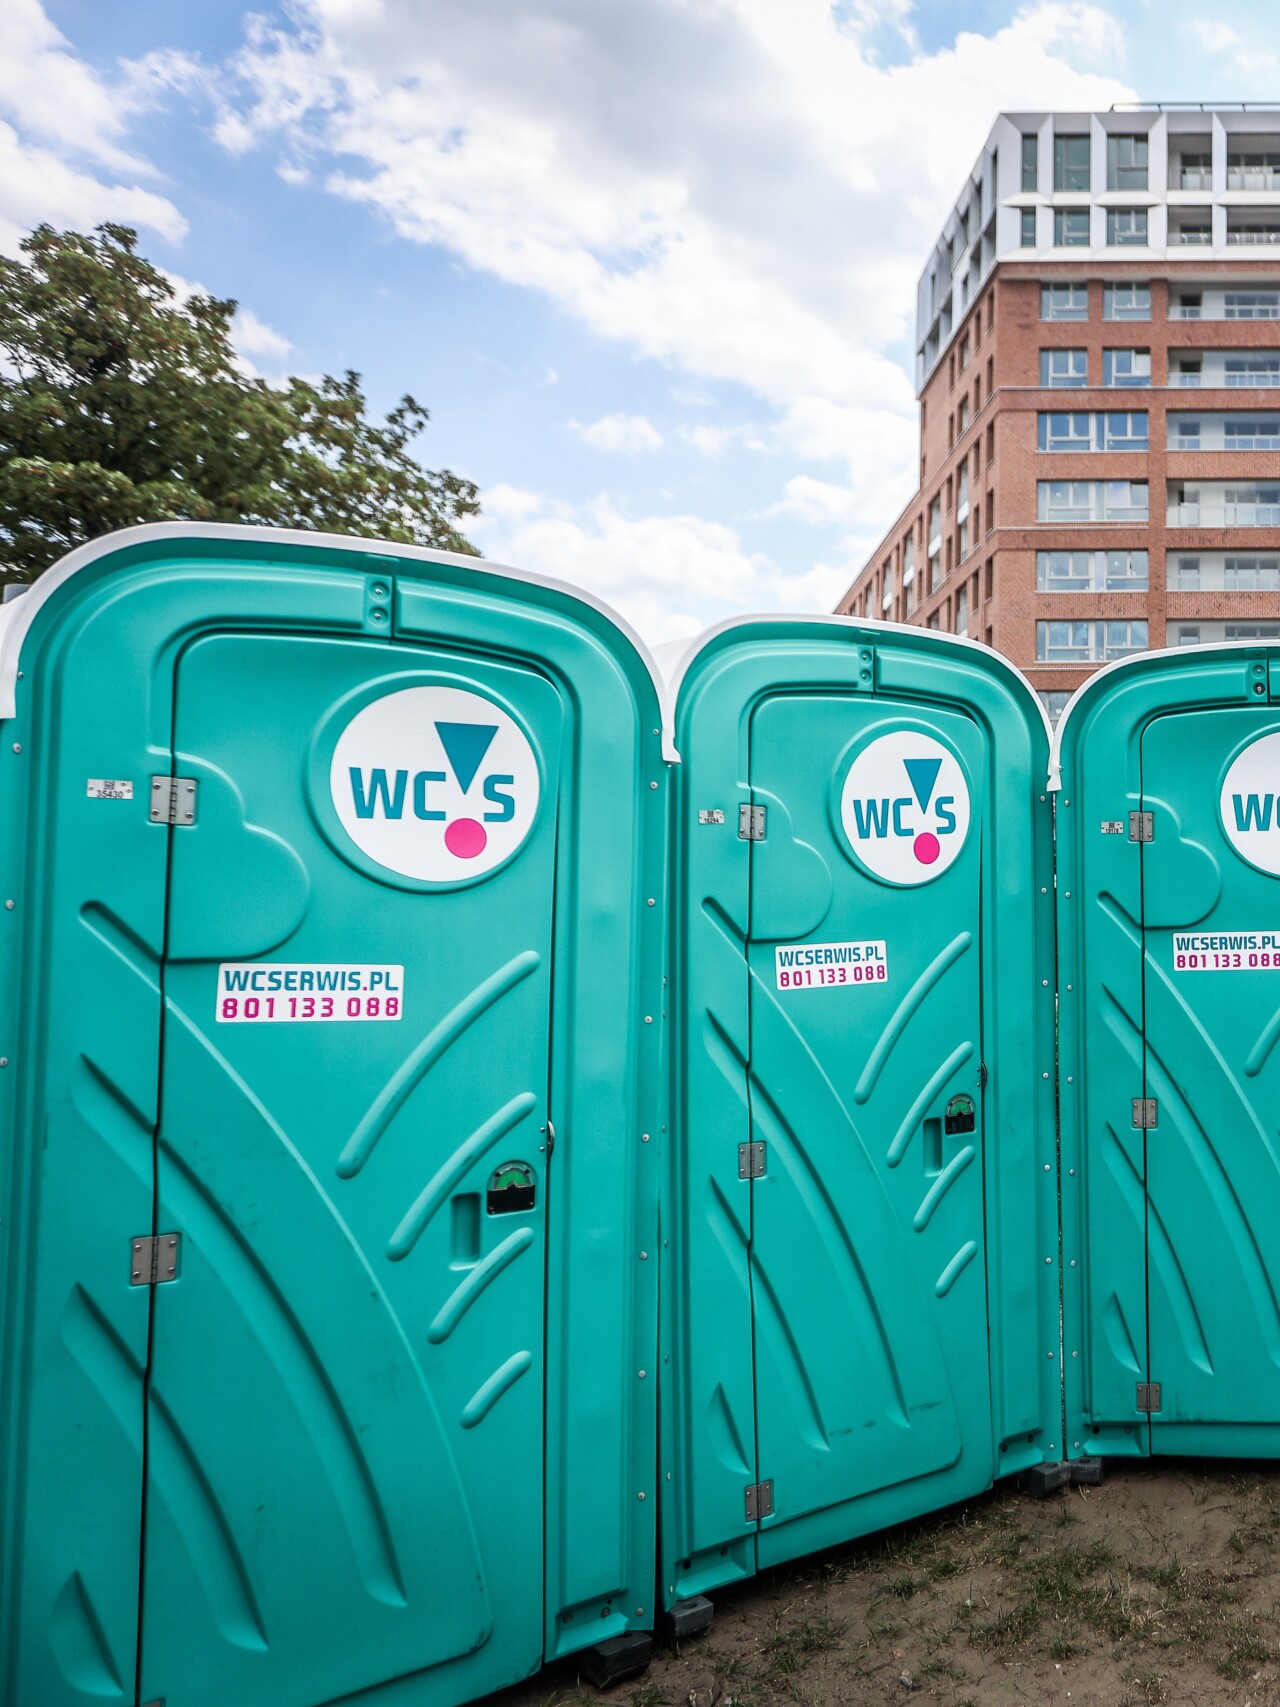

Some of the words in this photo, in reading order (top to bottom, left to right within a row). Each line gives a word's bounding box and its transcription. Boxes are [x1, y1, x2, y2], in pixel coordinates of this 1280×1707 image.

[778, 946, 885, 967] WCSERWIS.PL
[1176, 954, 1207, 968] 801
[1213, 954, 1241, 968] 133
[223, 970, 400, 992] WCSERWIS.PL
[780, 970, 812, 987] 801
[818, 968, 847, 985] 133
[853, 965, 886, 982] 088
[222, 997, 275, 1018] 801
[288, 997, 335, 1018] 133
[347, 997, 400, 1018] 088
